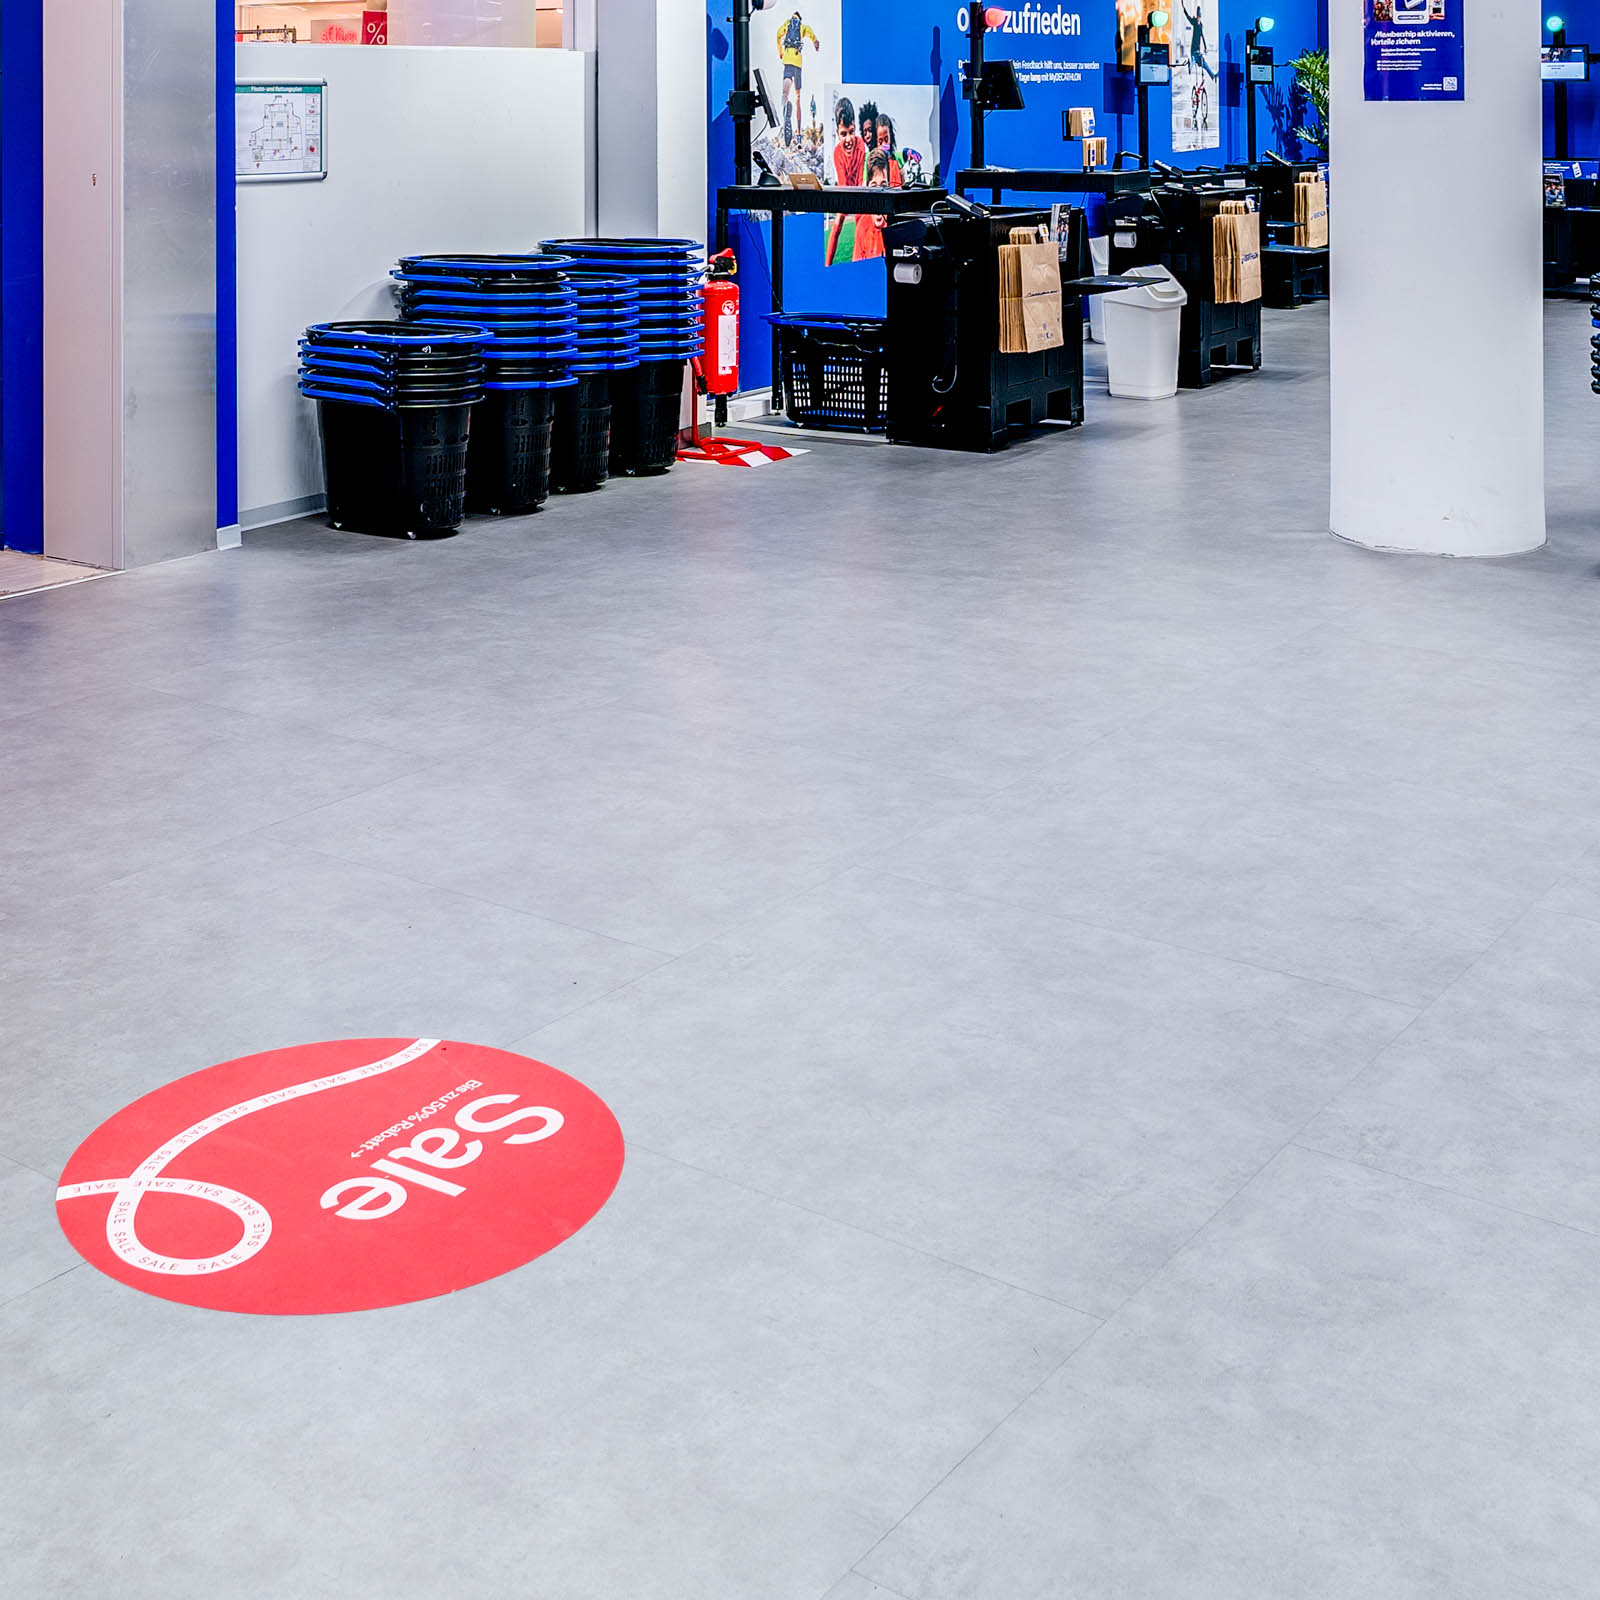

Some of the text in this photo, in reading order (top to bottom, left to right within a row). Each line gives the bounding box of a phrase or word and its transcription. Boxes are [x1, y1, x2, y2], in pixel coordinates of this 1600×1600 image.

[1002, 2, 1081, 36] zufrieden
[359, 1079, 483, 1151] Bis zu 50% Rabatt
[319, 1093, 565, 1220] Sale
[113, 1201, 131, 1224] SALE
[113, 1231, 136, 1253] SALE
[138, 1256, 180, 1272] SALE
[197, 1252, 242, 1272] SALE
